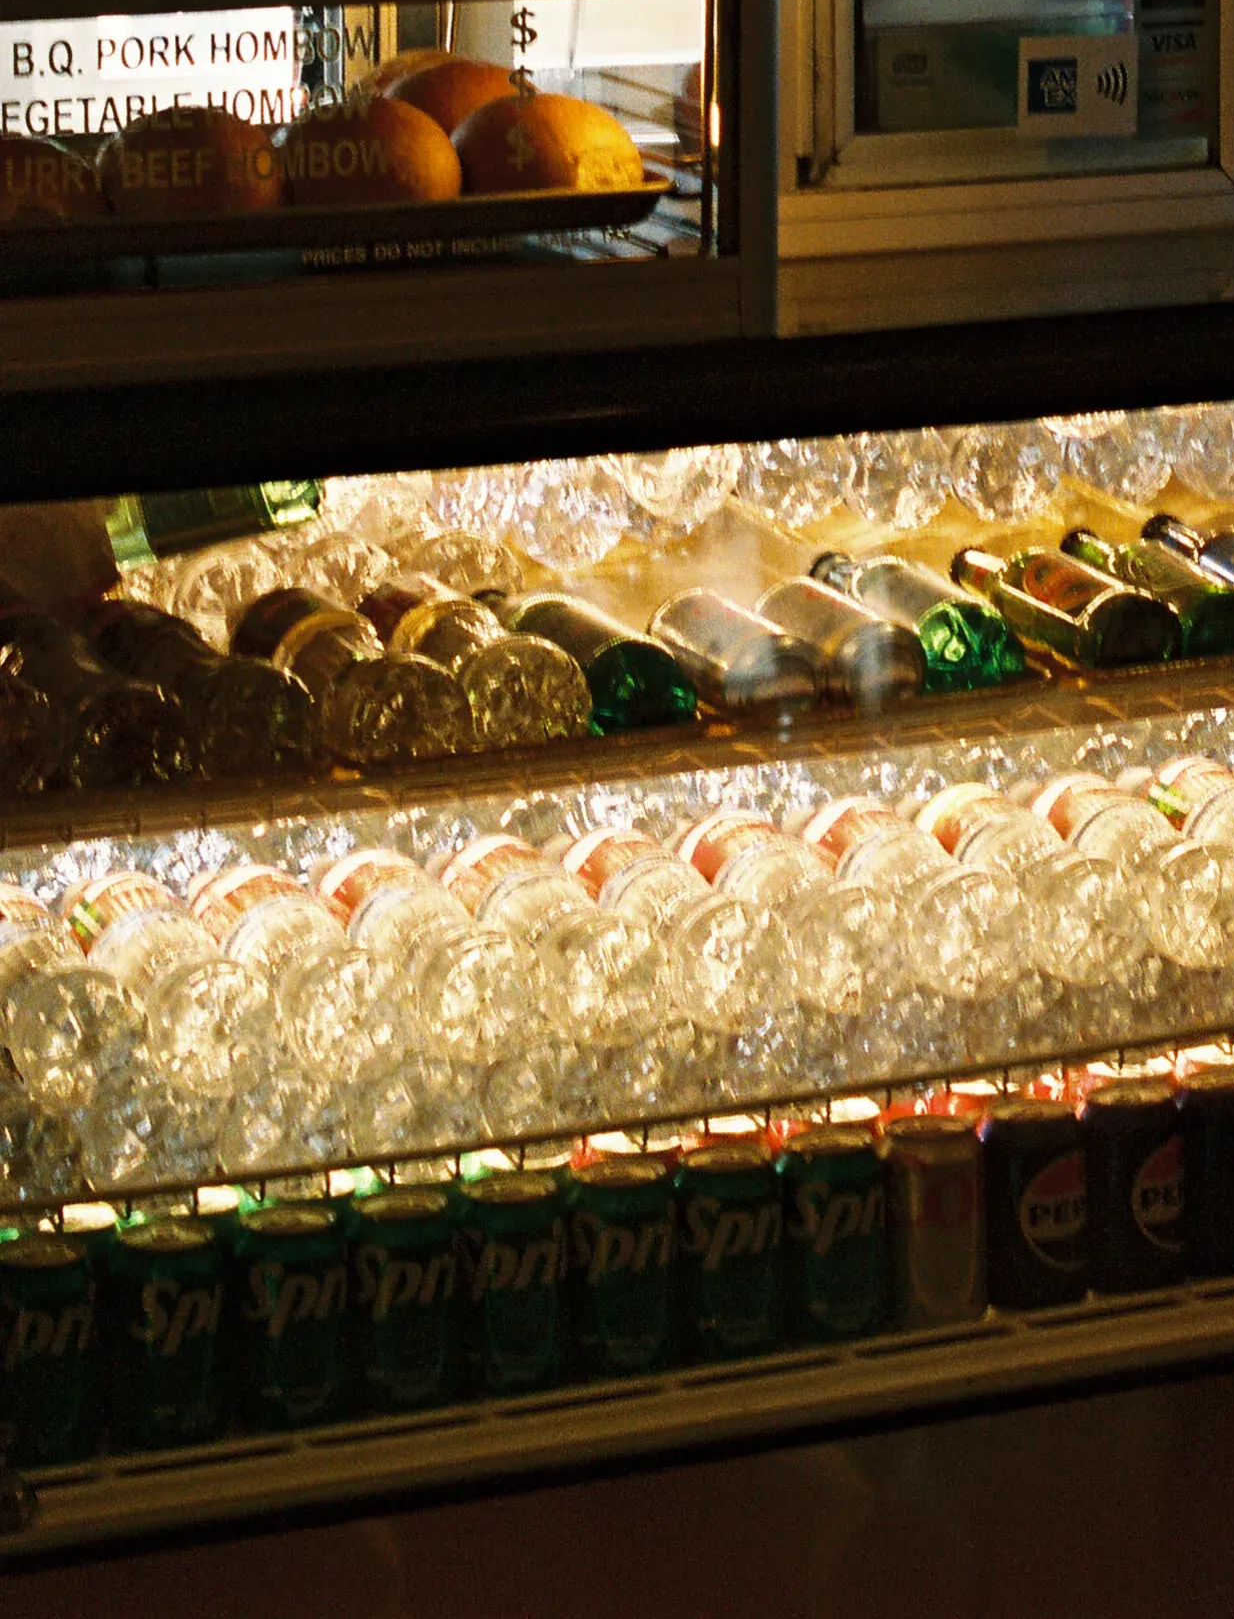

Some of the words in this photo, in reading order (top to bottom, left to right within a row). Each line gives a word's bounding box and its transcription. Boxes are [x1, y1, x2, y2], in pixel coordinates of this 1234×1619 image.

[97, 35, 196, 70] PORK
[209, 27, 378, 65] HOMBOW
[510, 7, 537, 53] $
[1152, 33, 1197, 53] VISA
[203, 83, 372, 125] HOMBOW
[121, 148, 214, 189] BEEF
[301, 245, 366, 267] PRICES
[373, 244, 401, 262] DO
[406, 240, 442, 259] NOT
